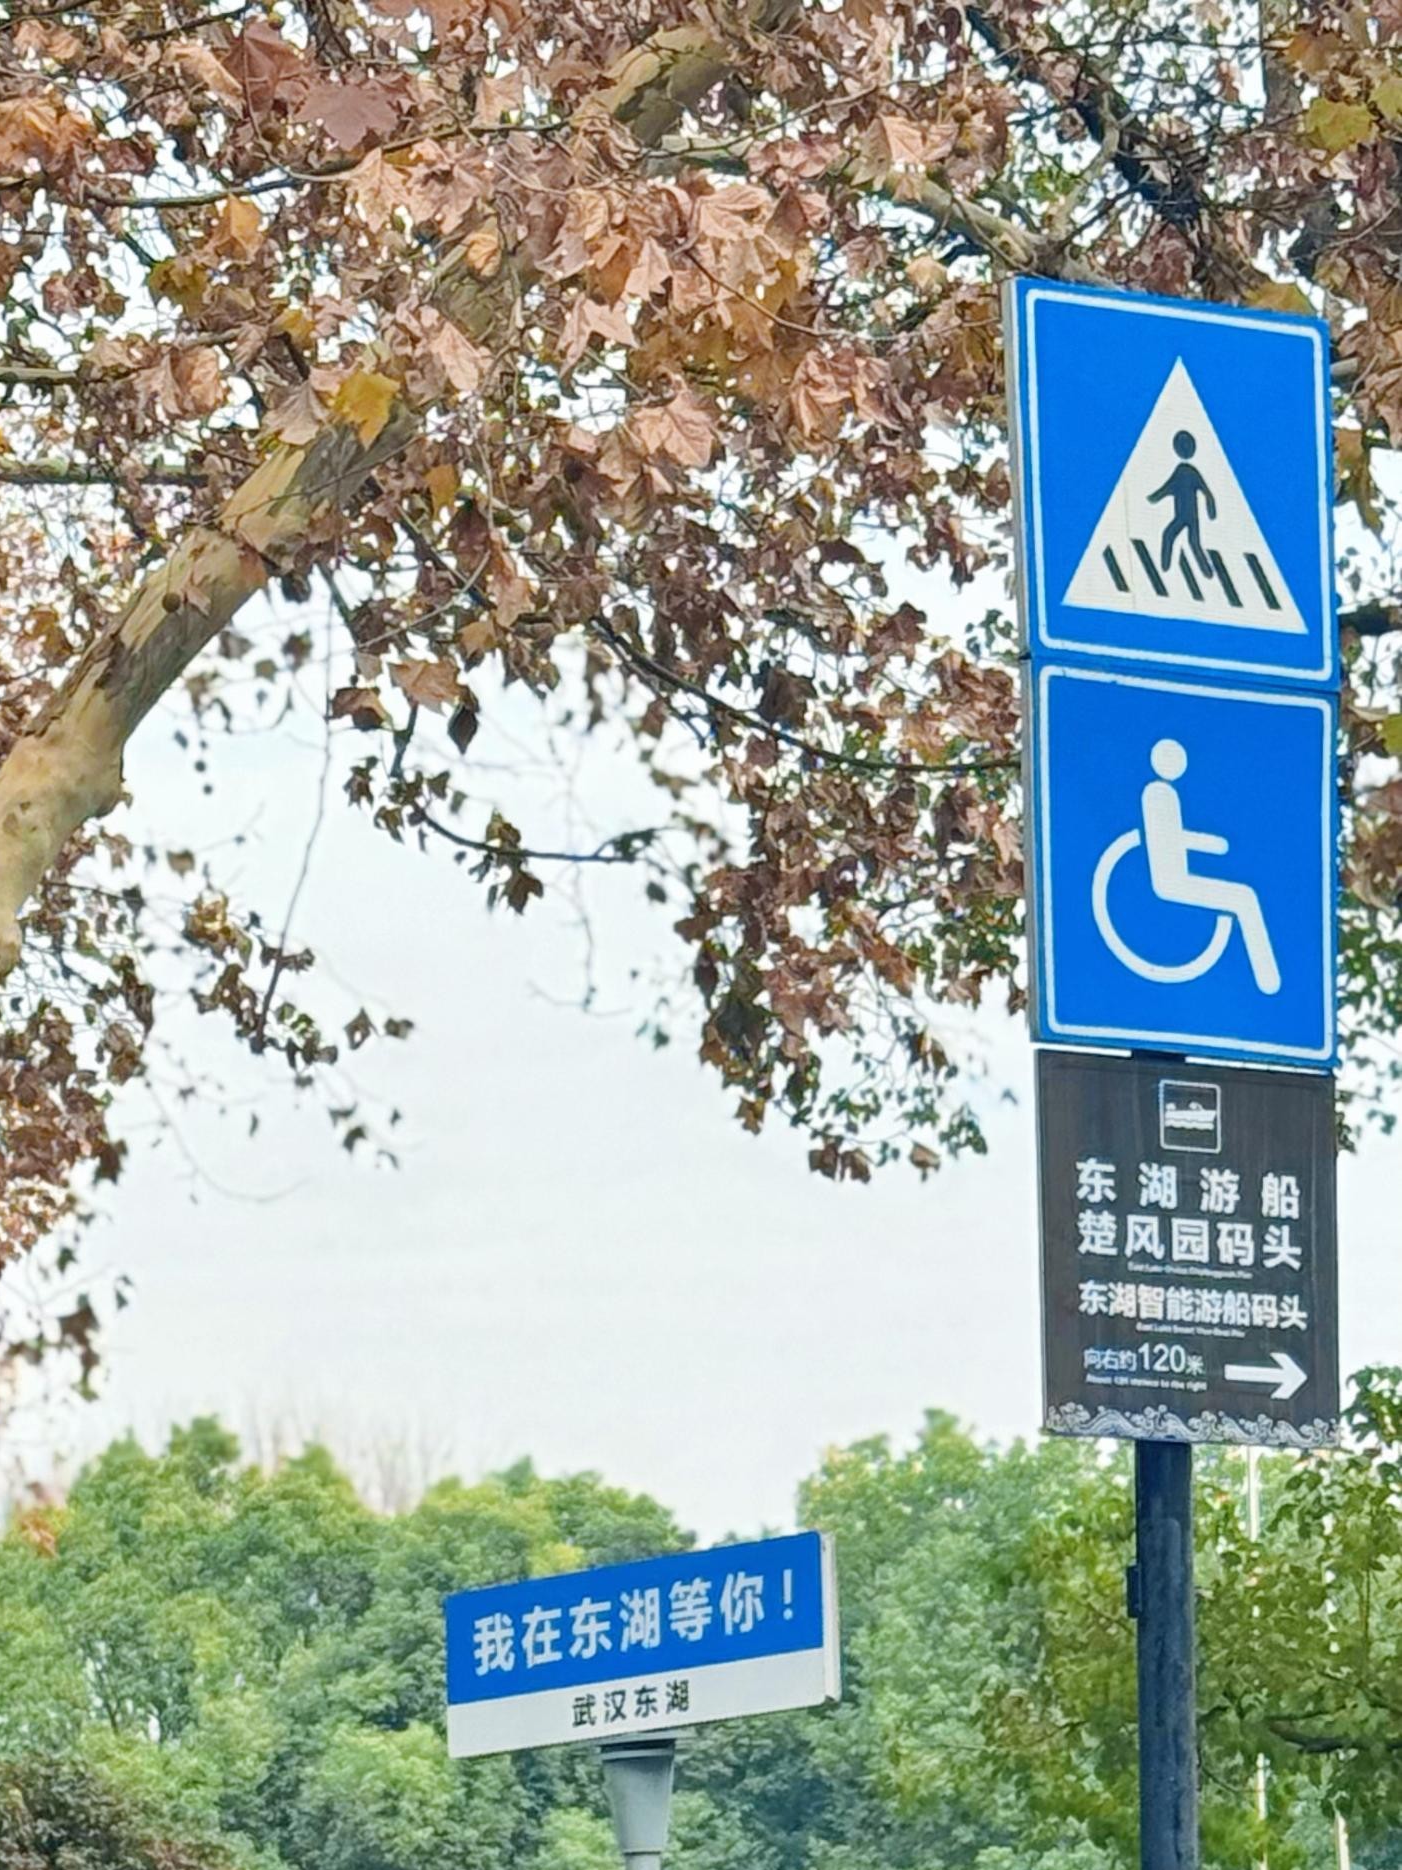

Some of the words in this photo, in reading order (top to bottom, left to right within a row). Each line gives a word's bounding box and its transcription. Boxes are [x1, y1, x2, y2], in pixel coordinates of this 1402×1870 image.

[1075, 1158, 1300, 1219] 东湖游船
[1077, 1210, 1302, 1271] 楚风园码头
[1078, 1280, 1307, 1331] 东湖智能游船码头
[1083, 1342, 1204, 1376] 向右约120米
[472, 1568, 795, 1677] 我在东湖等你！
[572, 1679, 691, 1728] 武汉东湖
